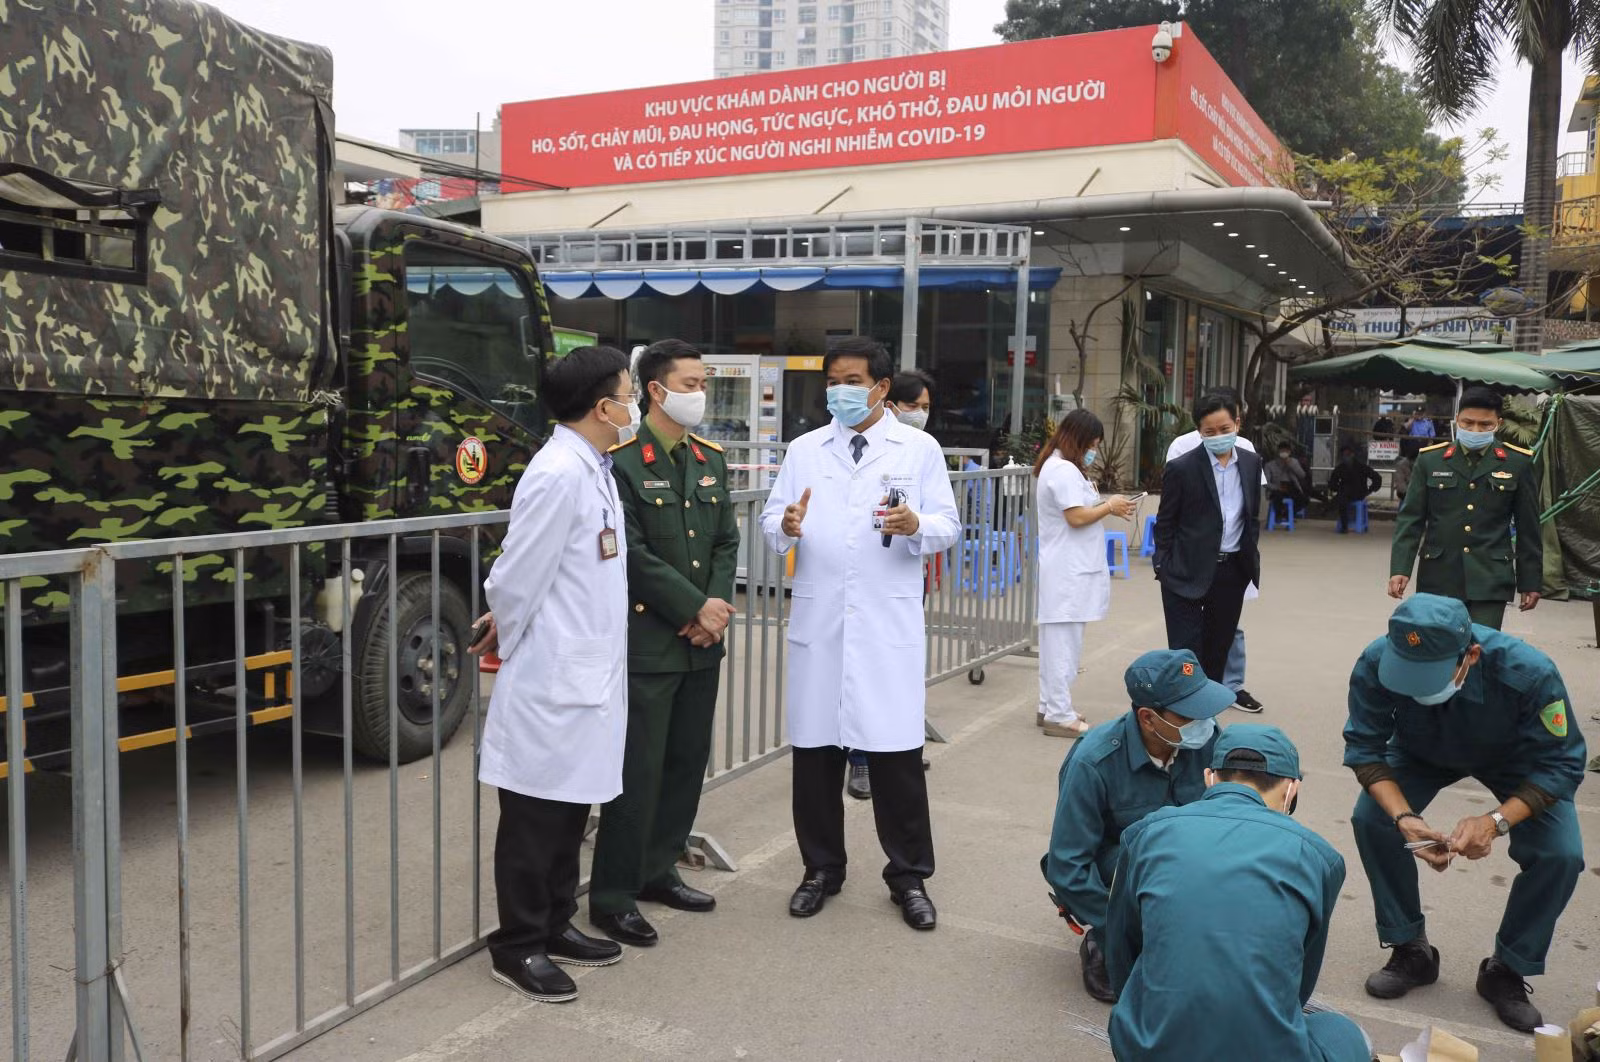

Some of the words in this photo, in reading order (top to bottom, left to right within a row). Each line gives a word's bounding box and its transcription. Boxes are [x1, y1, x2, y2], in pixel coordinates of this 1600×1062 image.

[531, 138, 556, 154] HO,
[558, 131, 588, 151] SỐT,
[591, 127, 630, 148] CHẢY
[632, 125, 666, 144] MŨI,
[669, 124, 702, 142] ĐAU
[705, 117, 758, 140] HỌNG,
[761, 111, 795, 132] TỨC
[798, 107, 853, 130] NGỰC,
[857, 100, 896, 123] KHÓ
[899, 94, 942, 118] THỞ,
[946, 93, 987, 115] ĐAU
[992, 85, 1031, 109] MỎI
[1036, 79, 1105, 106] NGƯỜI
[645, 102, 677, 118] KHU
[680, 95, 713, 117] VỰC
[716, 88, 766, 110] KHÁM
[769, 84, 818, 105] DÀNH
[822, 79, 860, 99] CHO
[863, 70, 924, 94] NGƯỜI
[929, 69, 946, 91] BỊ
[613, 152, 633, 171] VÀ
[636, 151, 657, 170] CÓ
[659, 146, 691, 168] TIẾP
[694, 145, 727, 165] XÚC
[730, 140, 784, 161] NGƯỜI
[788, 138, 831, 156] NGHI
[835, 127, 893, 153] NHIỄM
[897, 124, 985, 147] COVID-19
